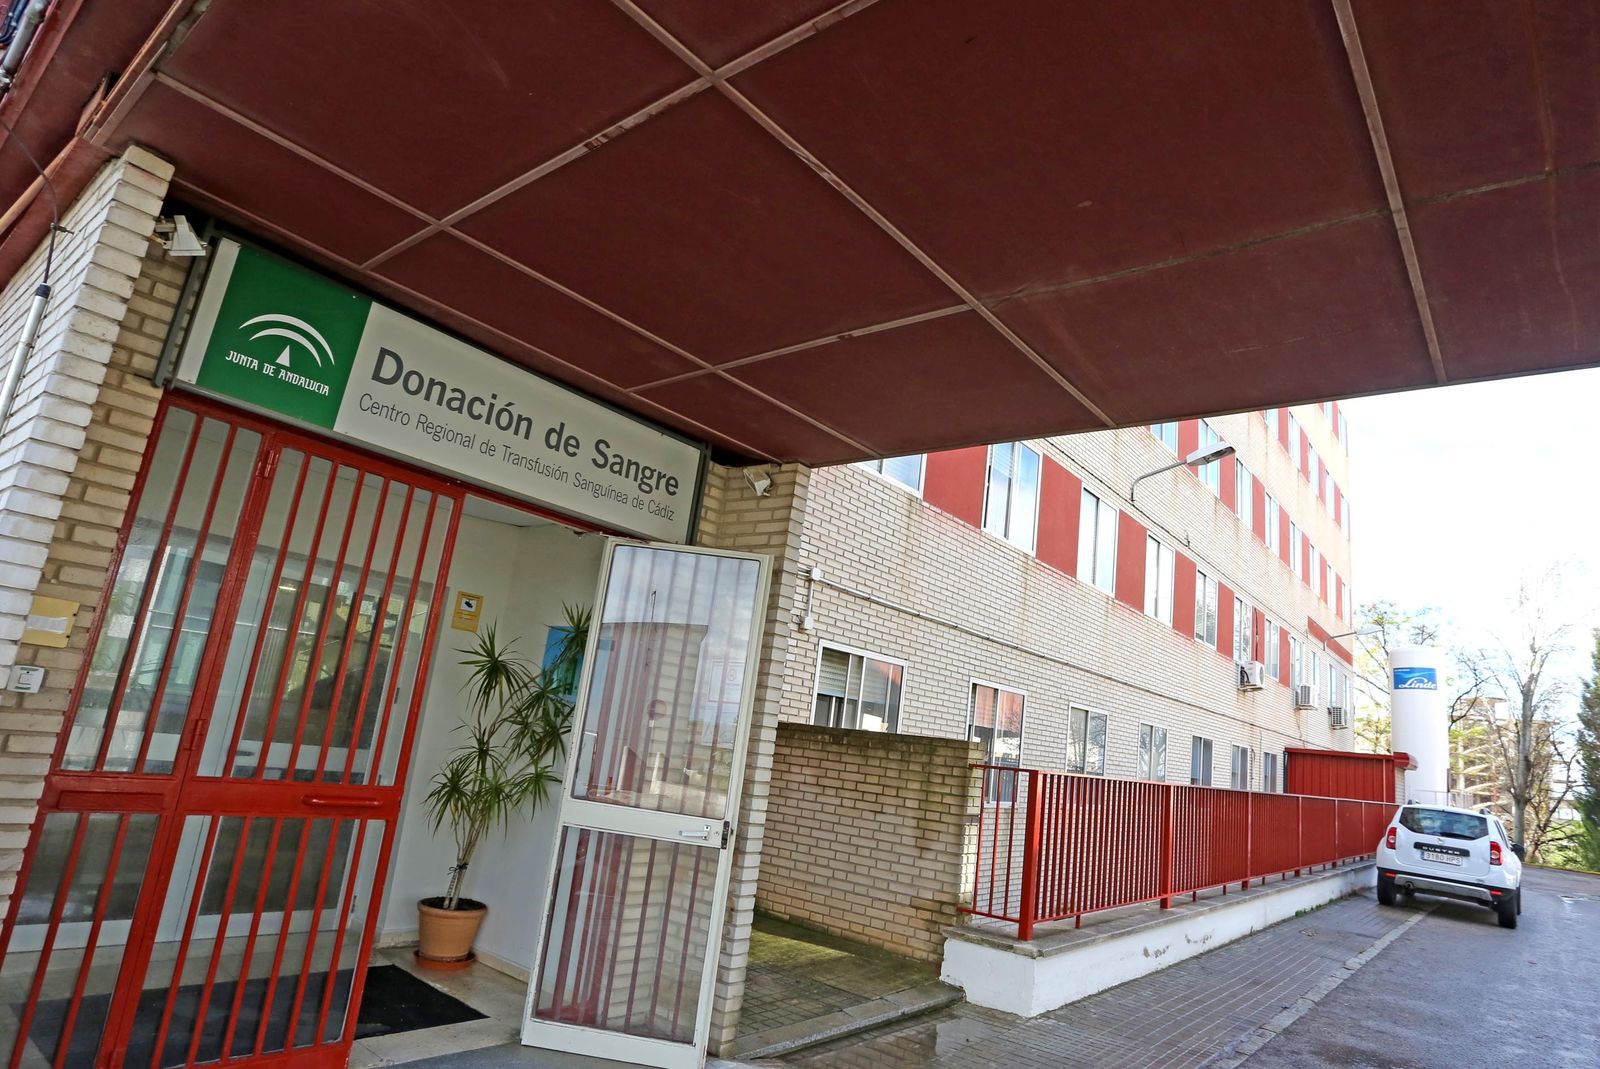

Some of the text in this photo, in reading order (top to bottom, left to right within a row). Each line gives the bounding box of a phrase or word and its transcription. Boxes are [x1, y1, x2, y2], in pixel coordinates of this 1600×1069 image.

[225, 350, 258, 371] JUNTA
[262, 362, 276, 377] DE
[371, 346, 679, 496] Donación de Sangre
[359, 393, 675, 521] Centro Regional de Transfusión Sanguínea de Cádiz
[1398, 676, 1437, 689] Linde
[1422, 846, 1460, 855] DUSTER
